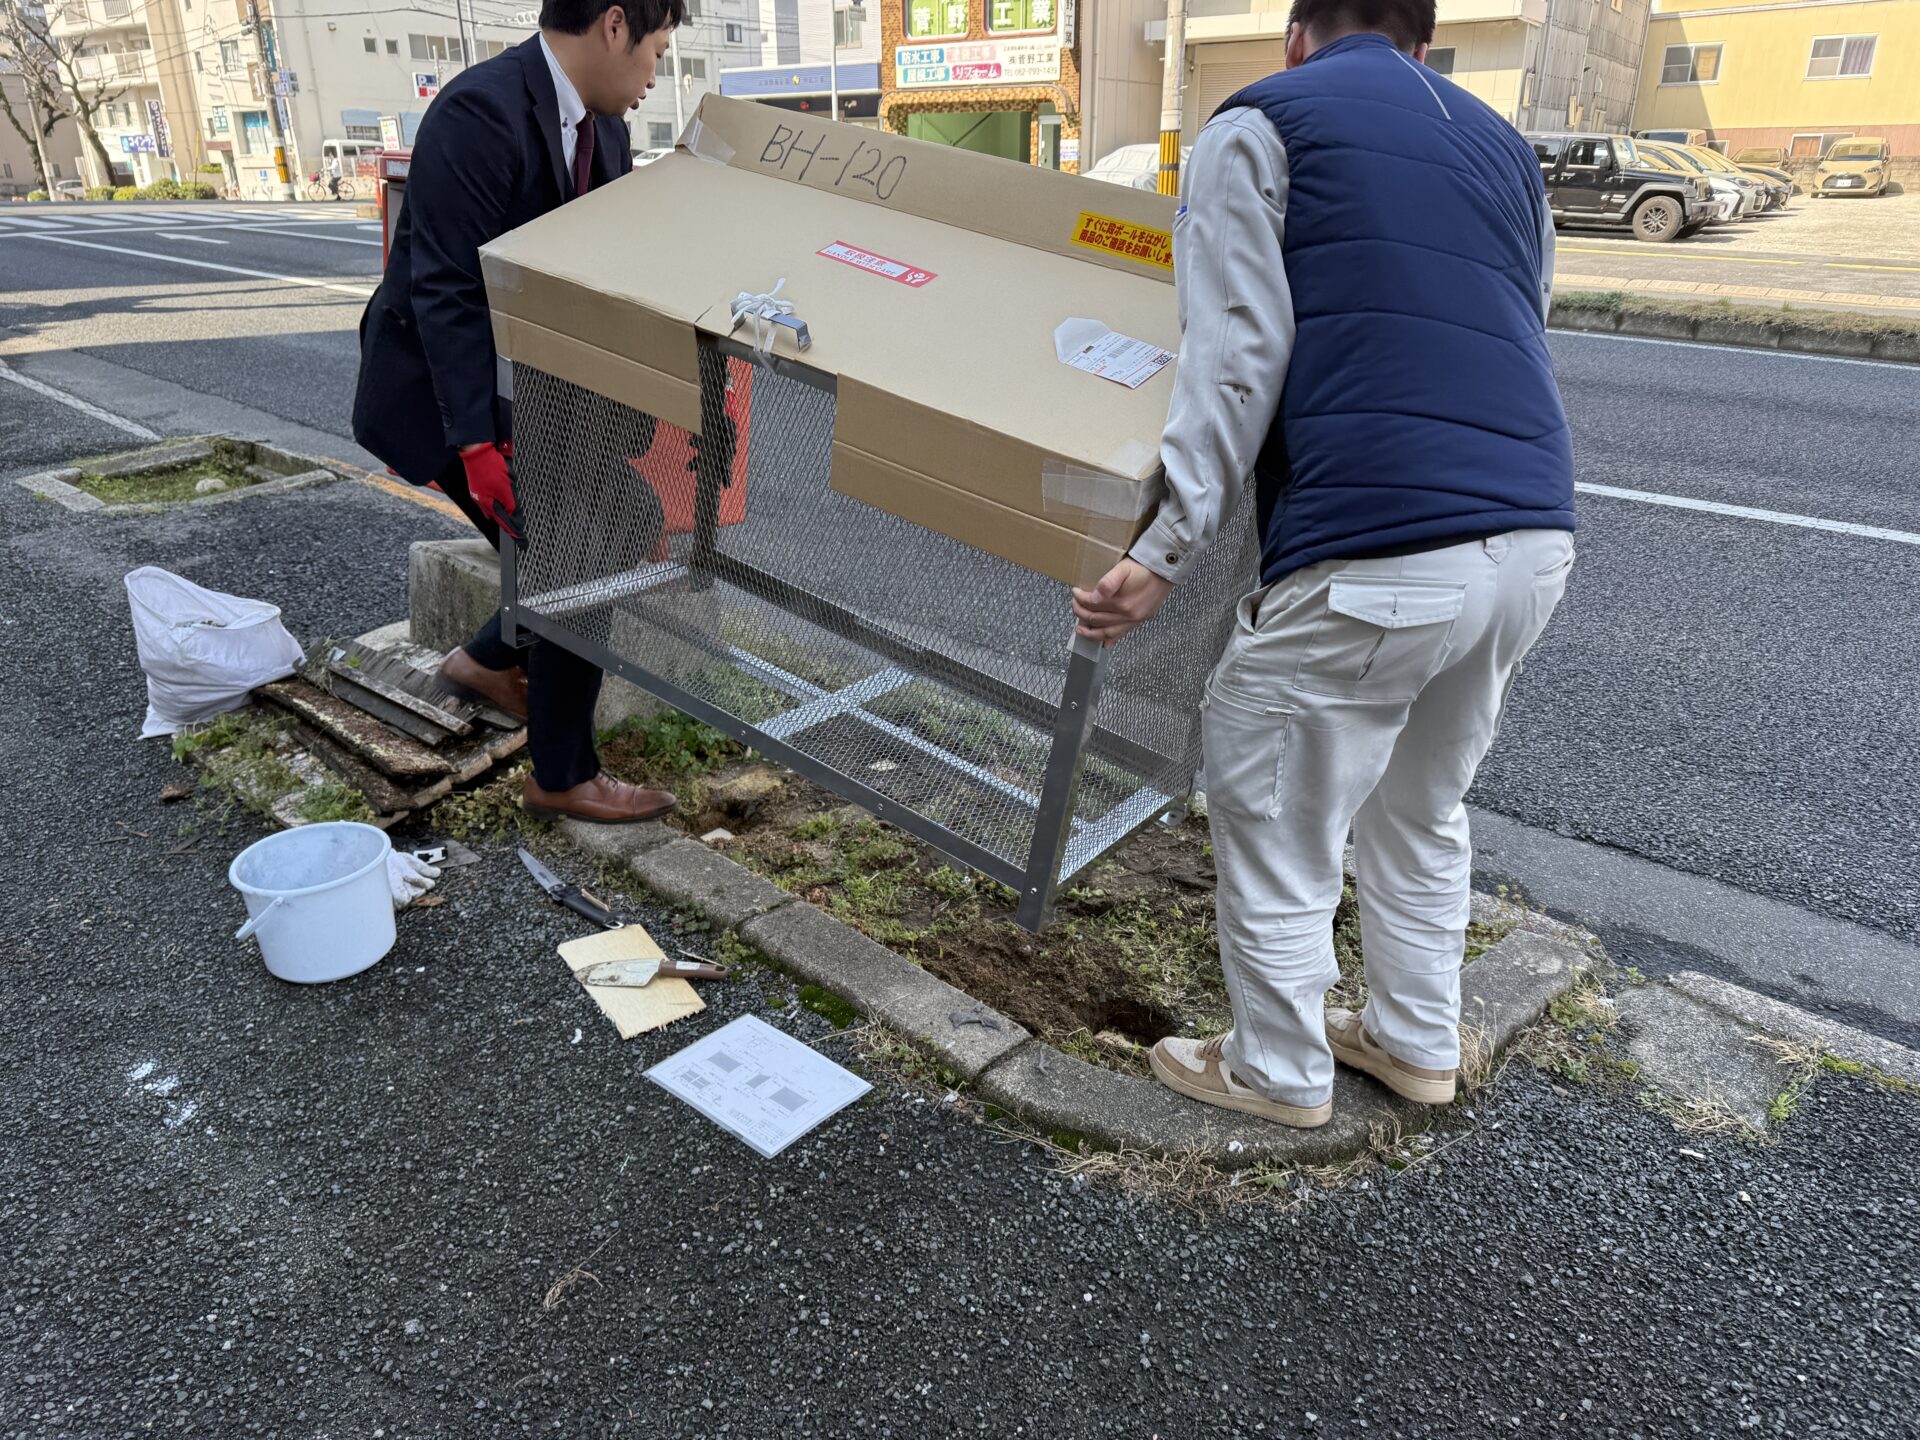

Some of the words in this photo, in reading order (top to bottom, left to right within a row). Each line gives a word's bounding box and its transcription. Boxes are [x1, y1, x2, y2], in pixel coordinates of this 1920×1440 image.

[901, 49, 941, 65] 防水工事
[759, 123, 907, 200] BH-120
[1078, 229, 1174, 265] 商品のご確認をお願いしま
[1083, 216, 1168, 249] すぐに段ボールをはがし
